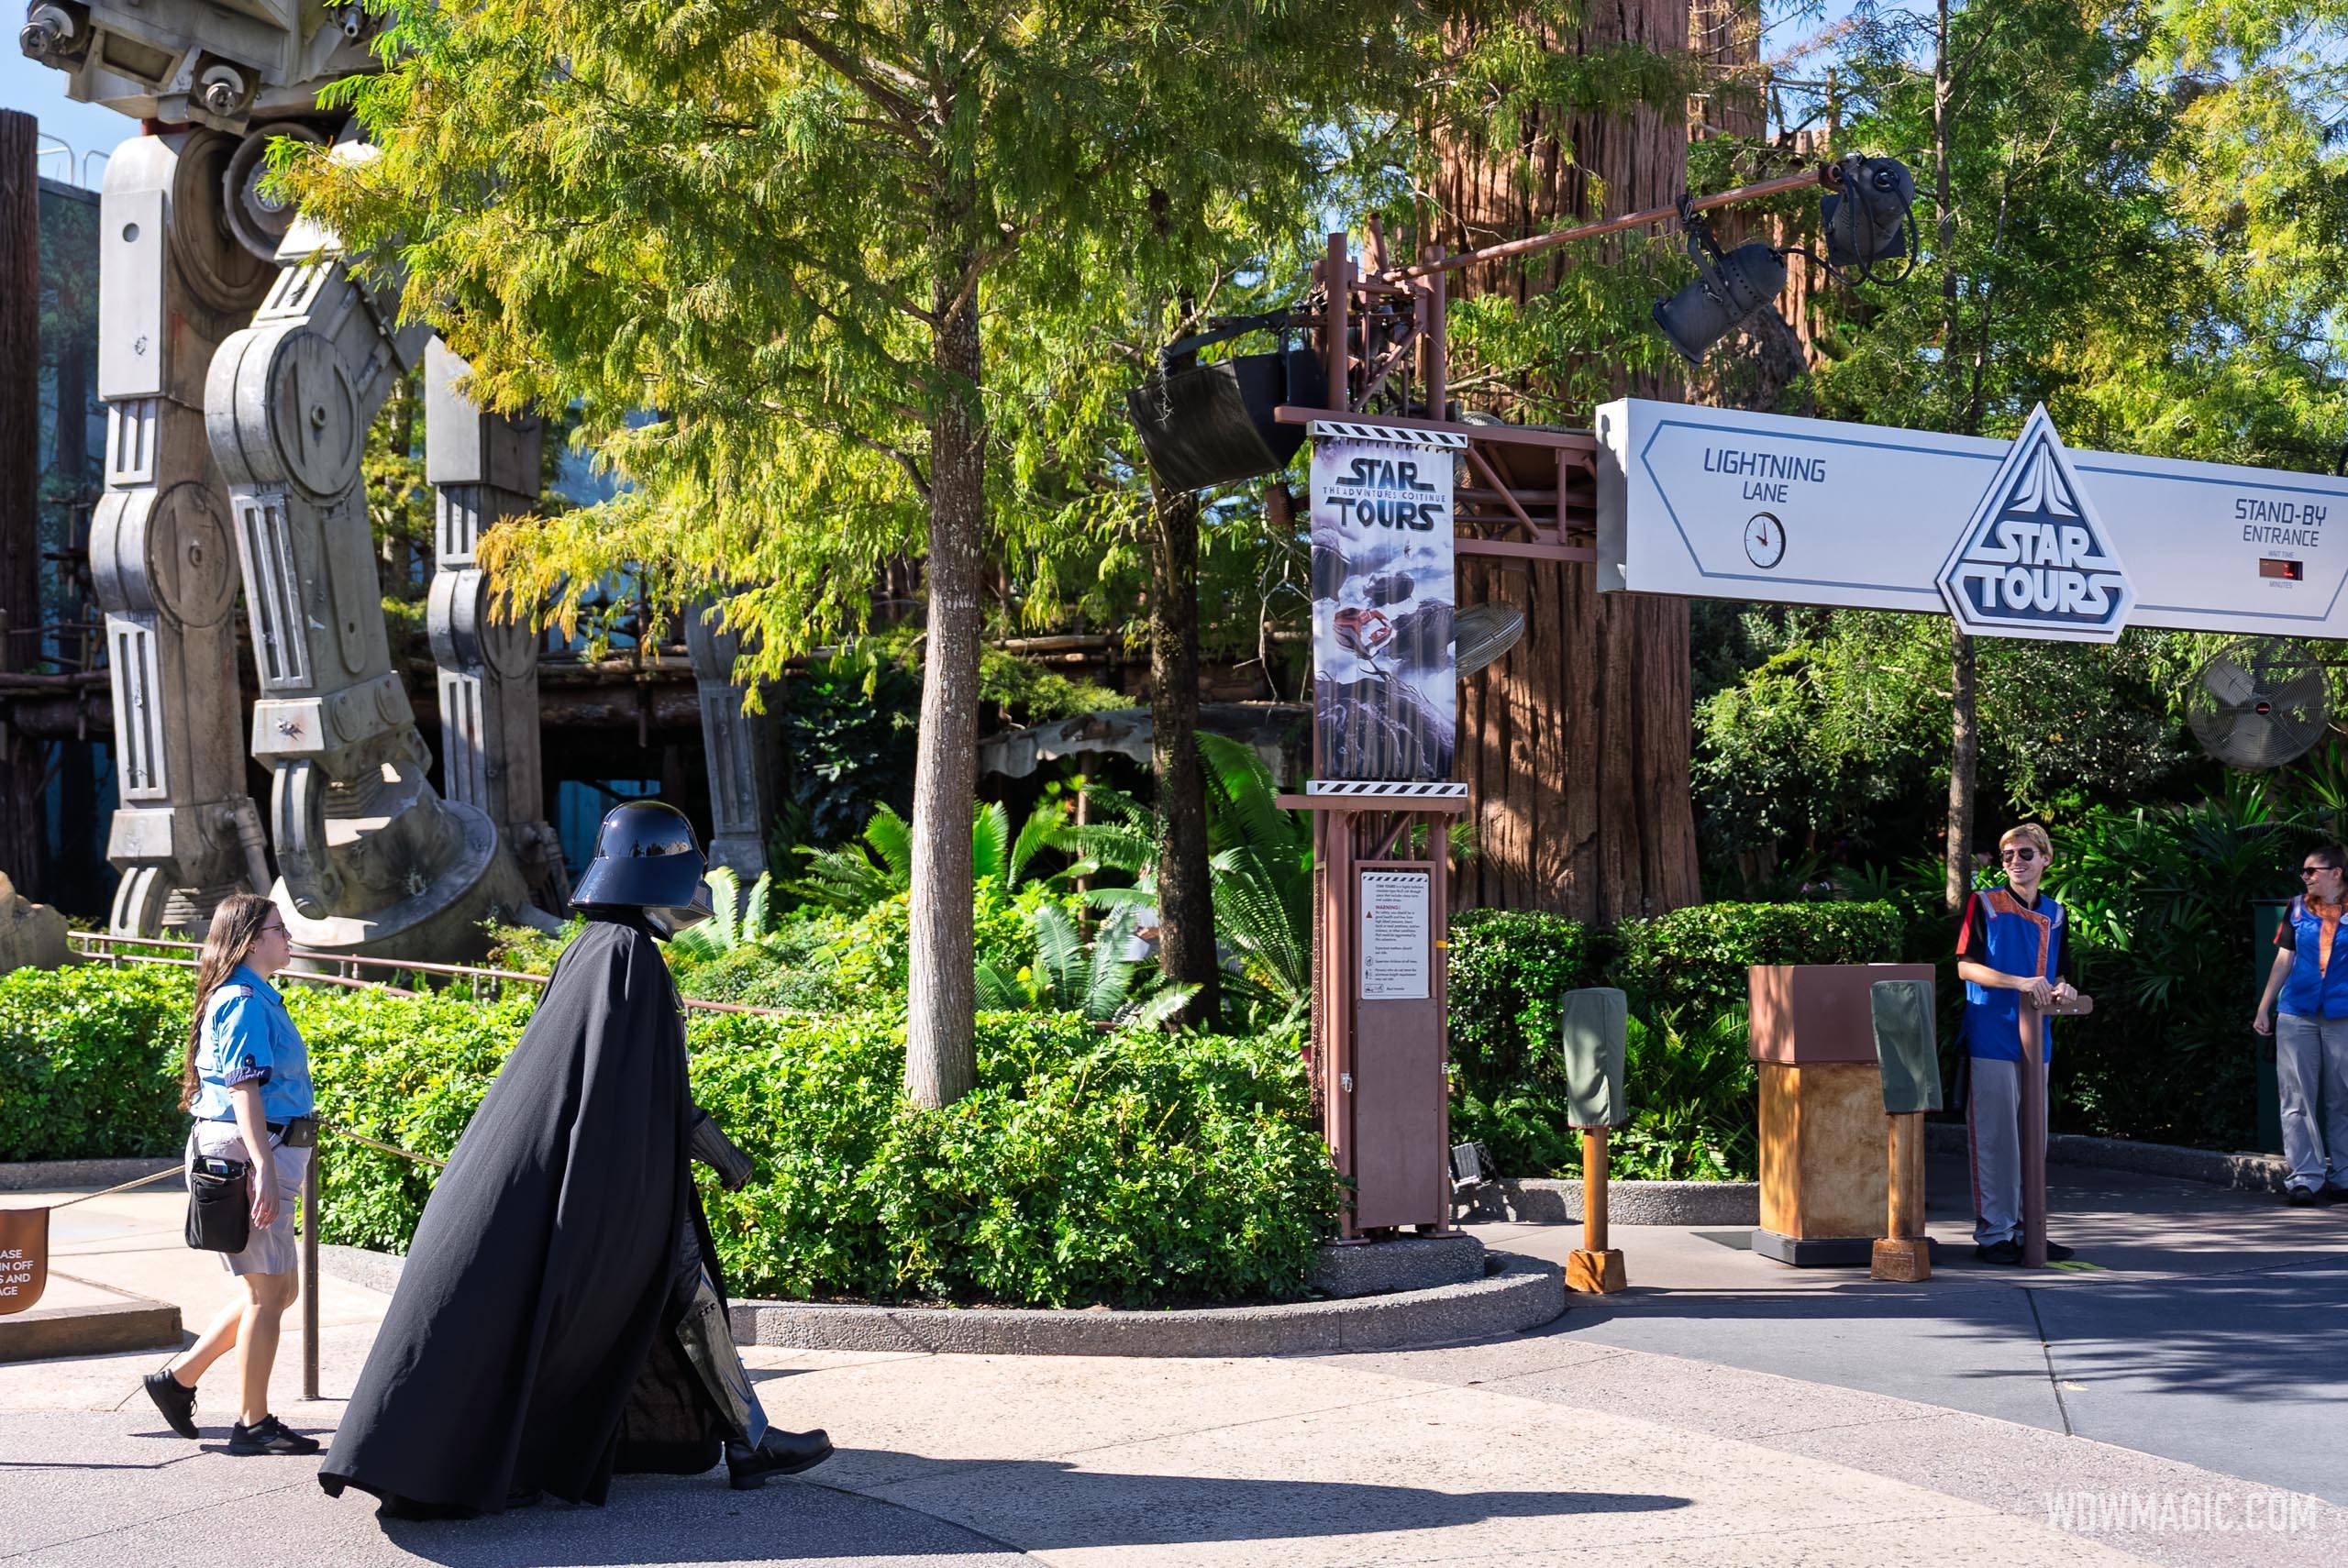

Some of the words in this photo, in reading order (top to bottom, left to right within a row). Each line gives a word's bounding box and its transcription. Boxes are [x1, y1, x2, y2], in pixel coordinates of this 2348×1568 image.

[1335, 458, 1436, 493] STAR
[1704, 447, 1826, 482] LIGHTNING
[1323, 487, 1340, 495] THE
[1743, 480, 1789, 503] LANE
[1325, 496, 1445, 532] TOURS
[2235, 498, 2327, 526] STAND-BY
[1961, 521, 2121, 572] STAR
[2243, 525, 2320, 547] ENTRANCE
[1955, 562, 2124, 616] TOURS
[6, 1273, 31, 1284] AND
[13, 1260, 34, 1271] OFF
